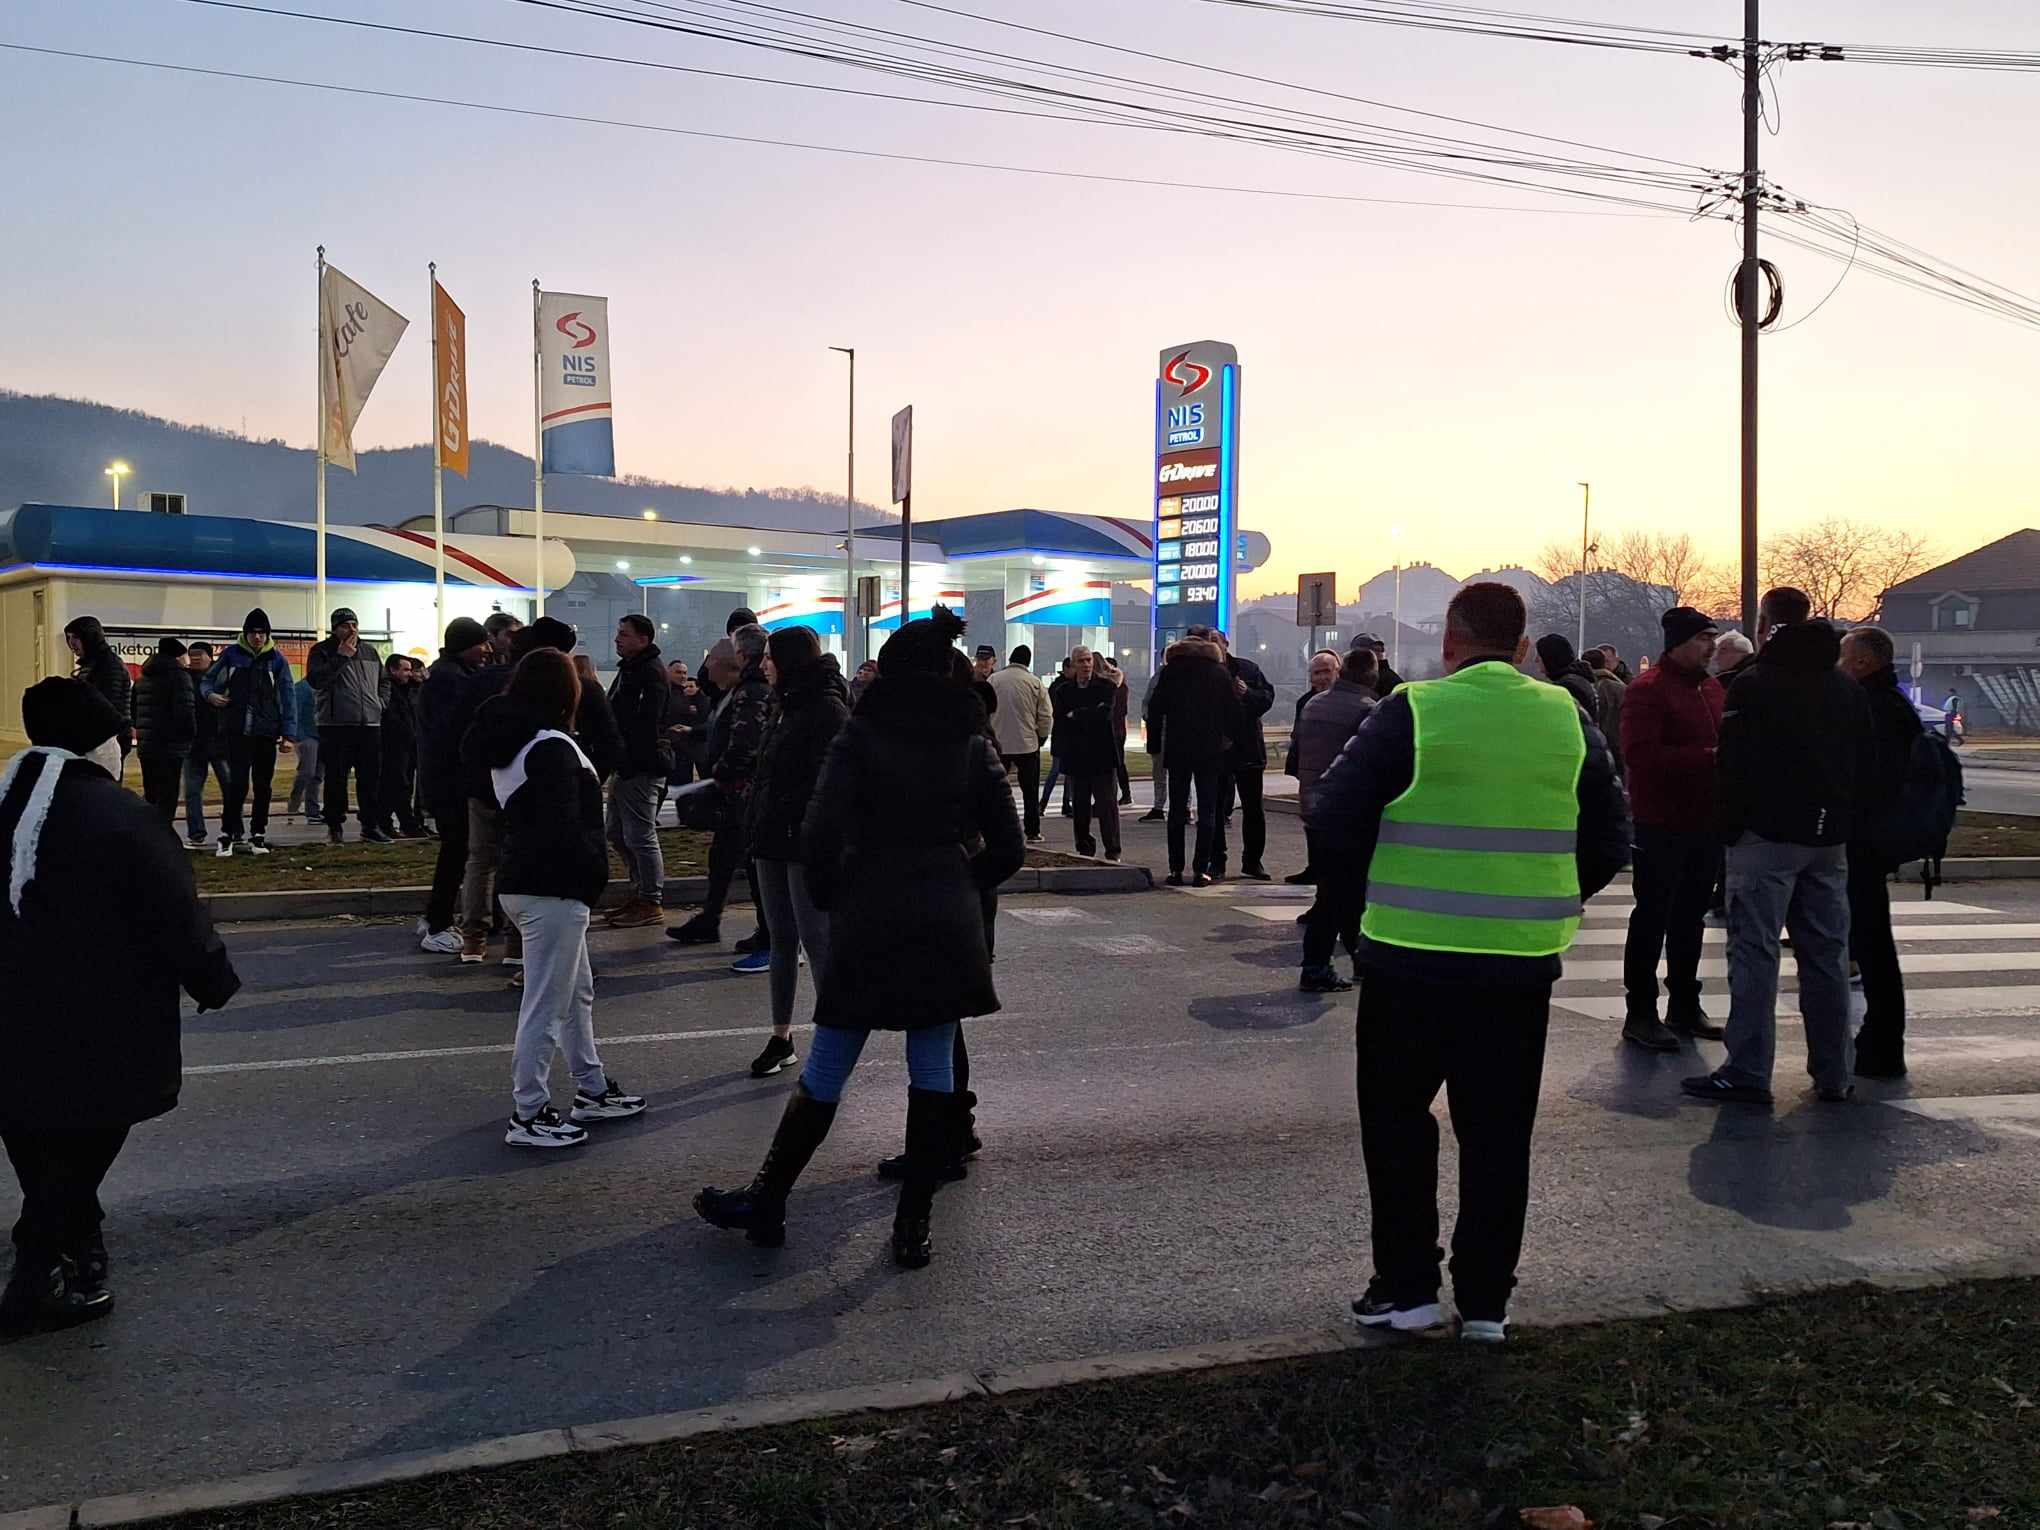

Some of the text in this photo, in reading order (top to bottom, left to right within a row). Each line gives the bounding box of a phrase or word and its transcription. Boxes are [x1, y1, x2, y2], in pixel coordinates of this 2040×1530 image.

[562, 354, 596, 372] NIS
[566, 376, 595, 385] PETROL
[1168, 403, 1204, 428] NIS
[1169, 431, 1199, 444] PETROL
